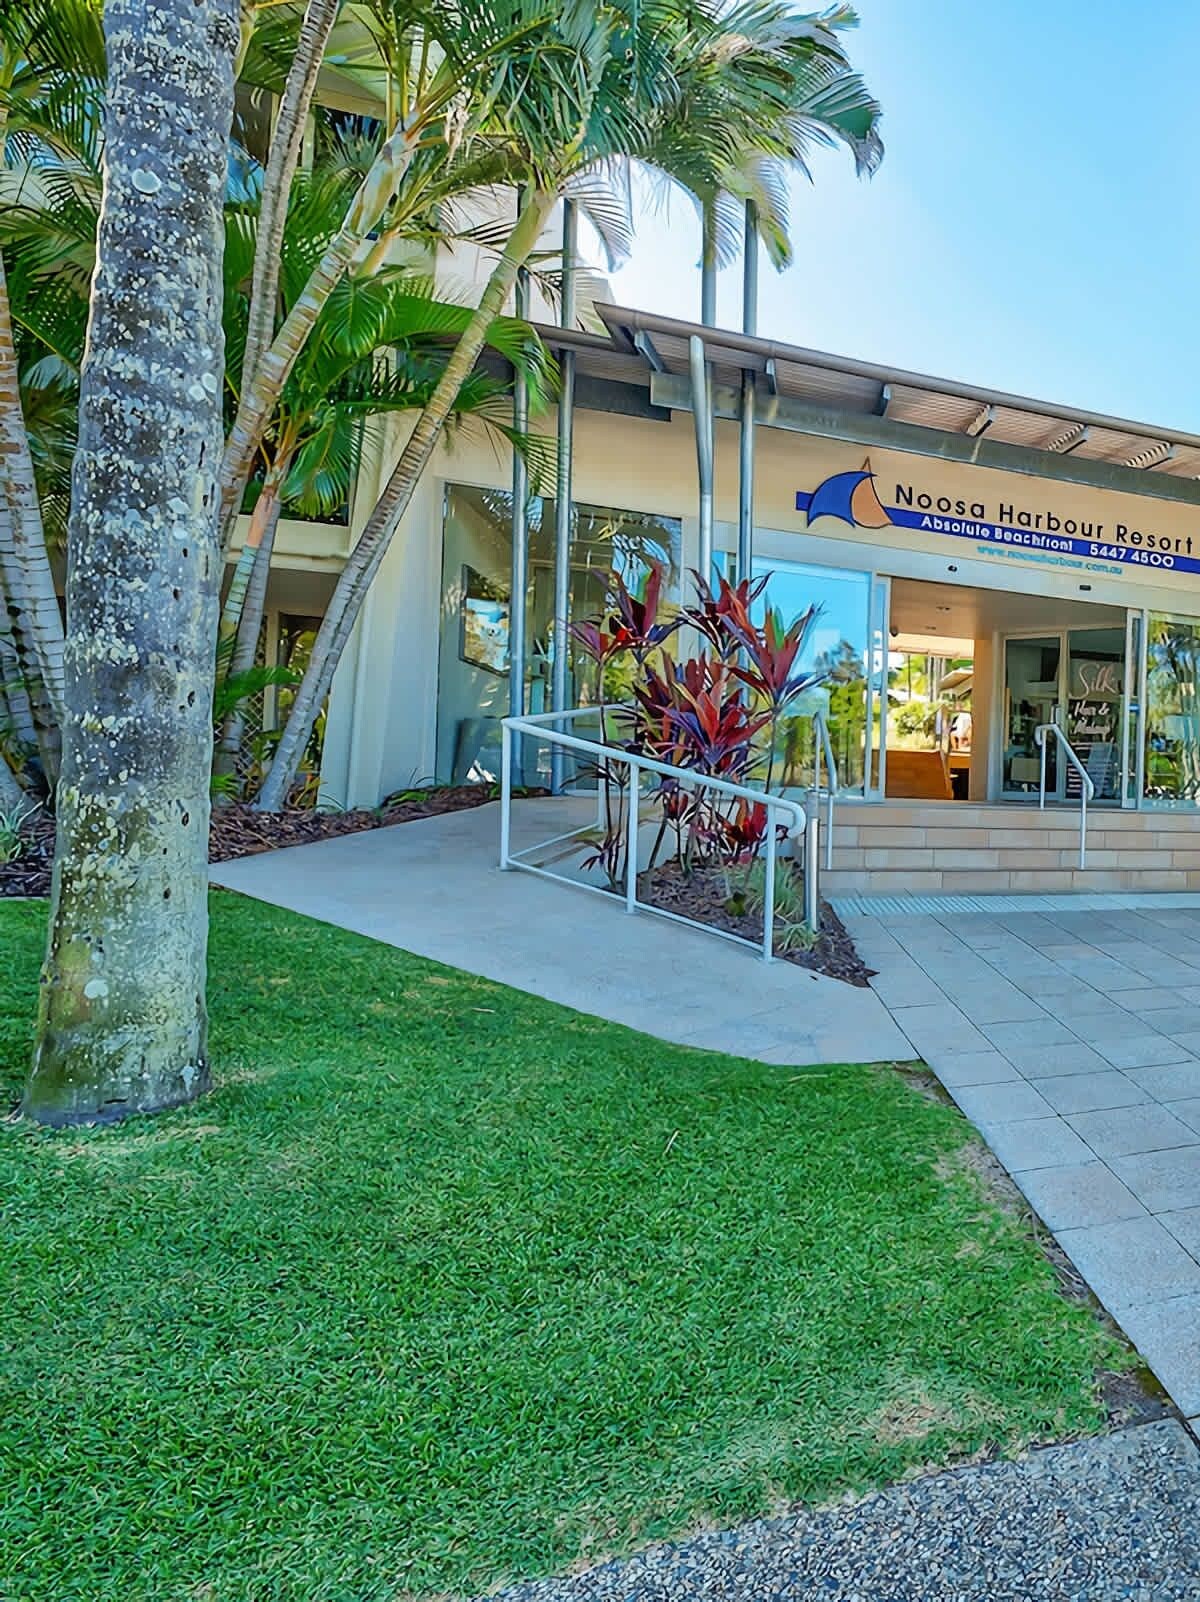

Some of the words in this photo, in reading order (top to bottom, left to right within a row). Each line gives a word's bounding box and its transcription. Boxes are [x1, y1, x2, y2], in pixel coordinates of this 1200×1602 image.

[895, 484, 985, 519] Noosa
[999, 503, 1103, 539] Harbour
[1116, 524, 1193, 554] Resort
[921, 516, 991, 538] Absolute
[994, 527, 1073, 552] Beachfront
[1090, 543, 1127, 560] 5447
[1131, 548, 1175, 568] 4500
